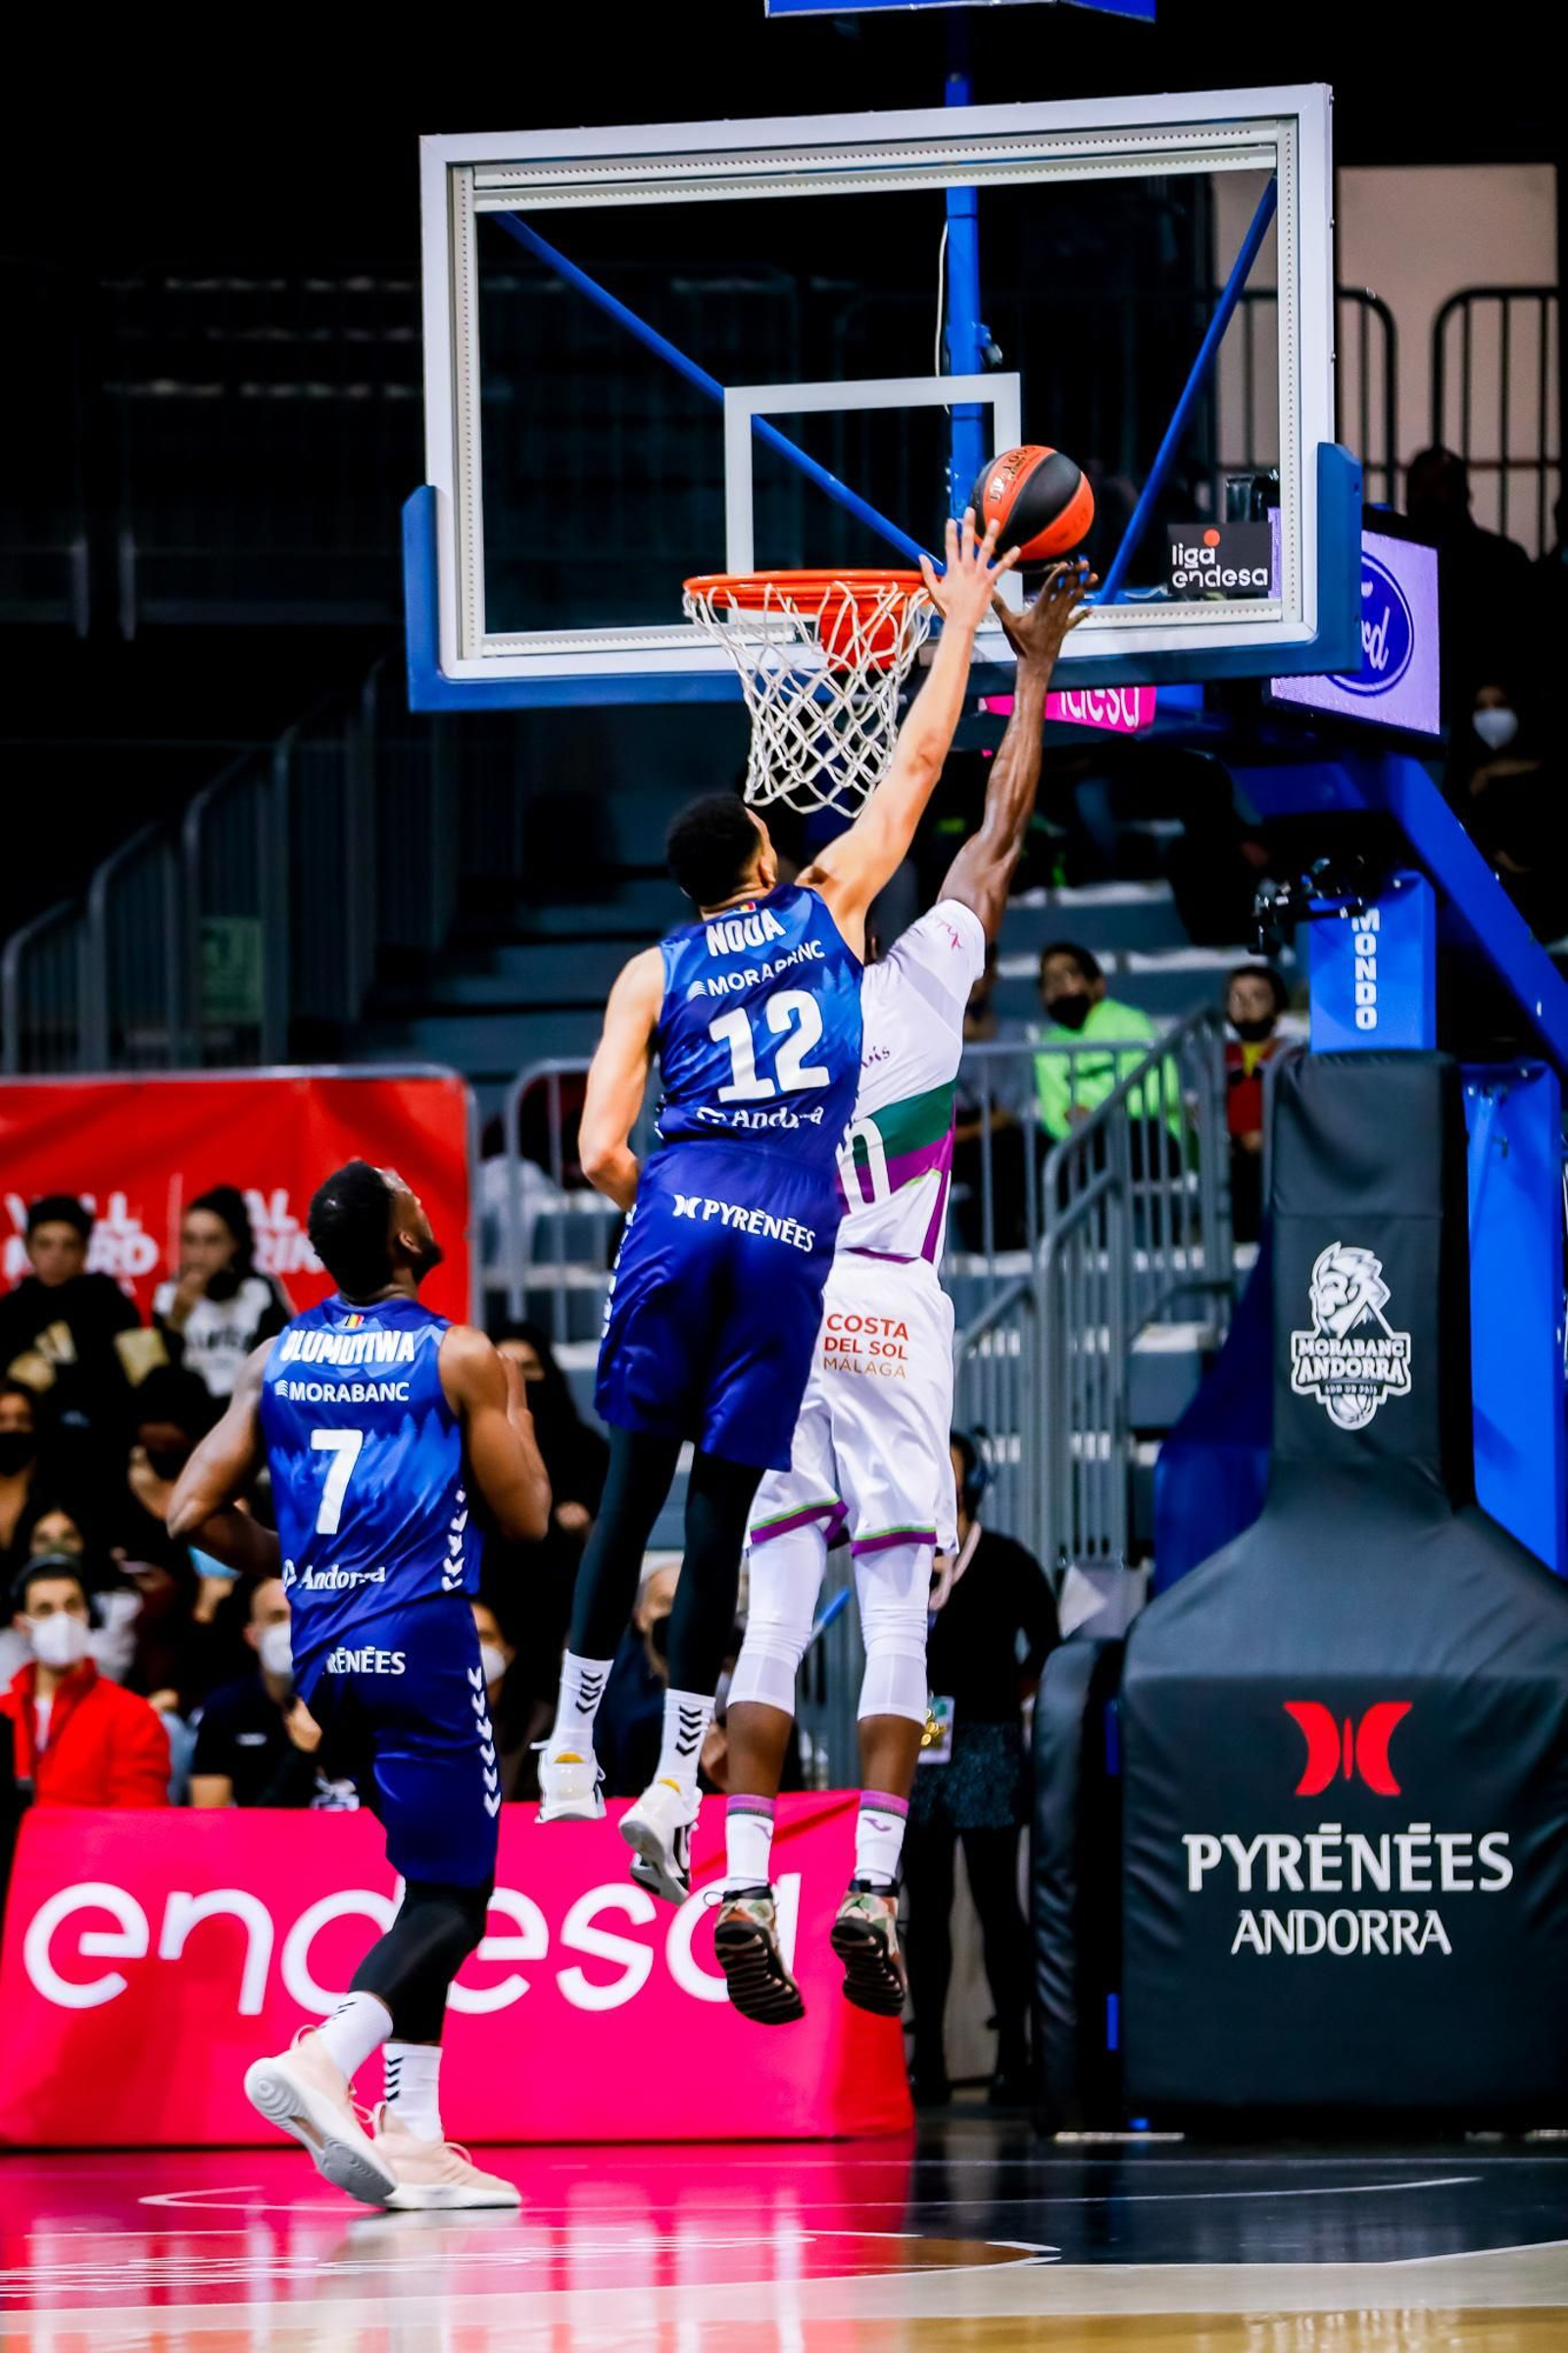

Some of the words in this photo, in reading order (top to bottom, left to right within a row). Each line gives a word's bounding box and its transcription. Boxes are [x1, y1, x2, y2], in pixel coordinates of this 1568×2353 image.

[1171, 543, 1216, 568] liga
[1171, 565, 1268, 588] endesa
[706, 908, 786, 956] NOUA
[1350, 907, 1380, 1030] MONDO
[709, 990, 830, 1103] 12
[826, 1313, 908, 1342] COSTA
[824, 1337, 862, 1353] DEL
[869, 1341, 907, 1360] SOL
[1298, 1339, 1404, 1357] MORABANC
[824, 1354, 906, 1379] MÁLAGA
[1298, 1356, 1405, 1384] ANDORRA
[288, 1382, 410, 1402] MORABANC
[311, 1429, 364, 1535] 7
[1231, 1909, 1453, 1955] ANDORRA
